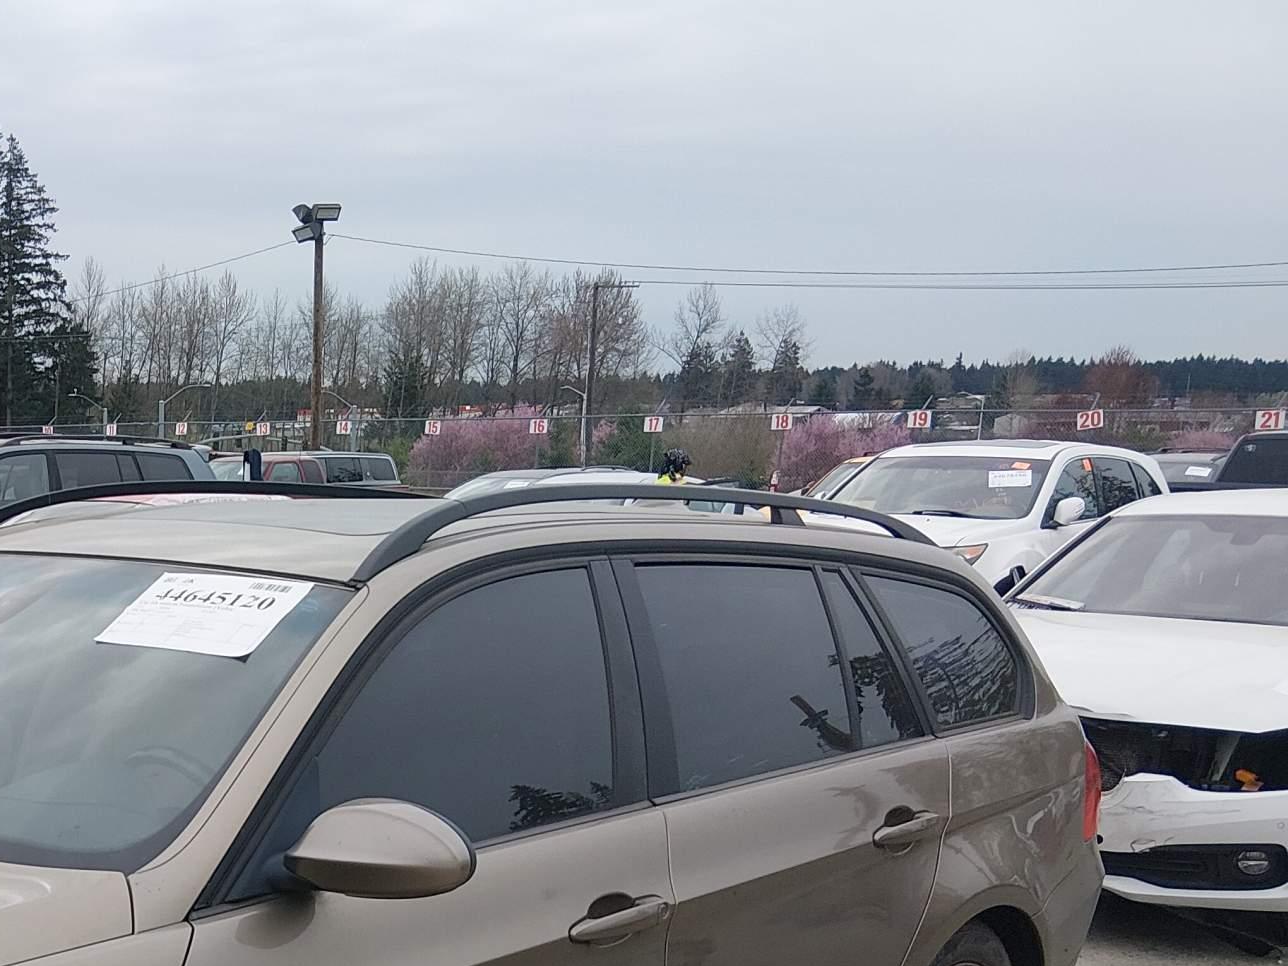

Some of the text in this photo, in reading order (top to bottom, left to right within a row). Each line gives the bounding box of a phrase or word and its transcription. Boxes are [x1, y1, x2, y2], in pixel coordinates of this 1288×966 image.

[533, 420, 545, 433] 16
[648, 417, 663, 431] 17
[775, 414, 789, 429] 18
[912, 411, 928, 427] 19
[1080, 411, 1102, 429] 20
[1259, 411, 1281, 429] 21
[178, 423, 186, 435] 12
[427, 421, 438, 434] 15
[156, 587, 276, 611] 44645120
